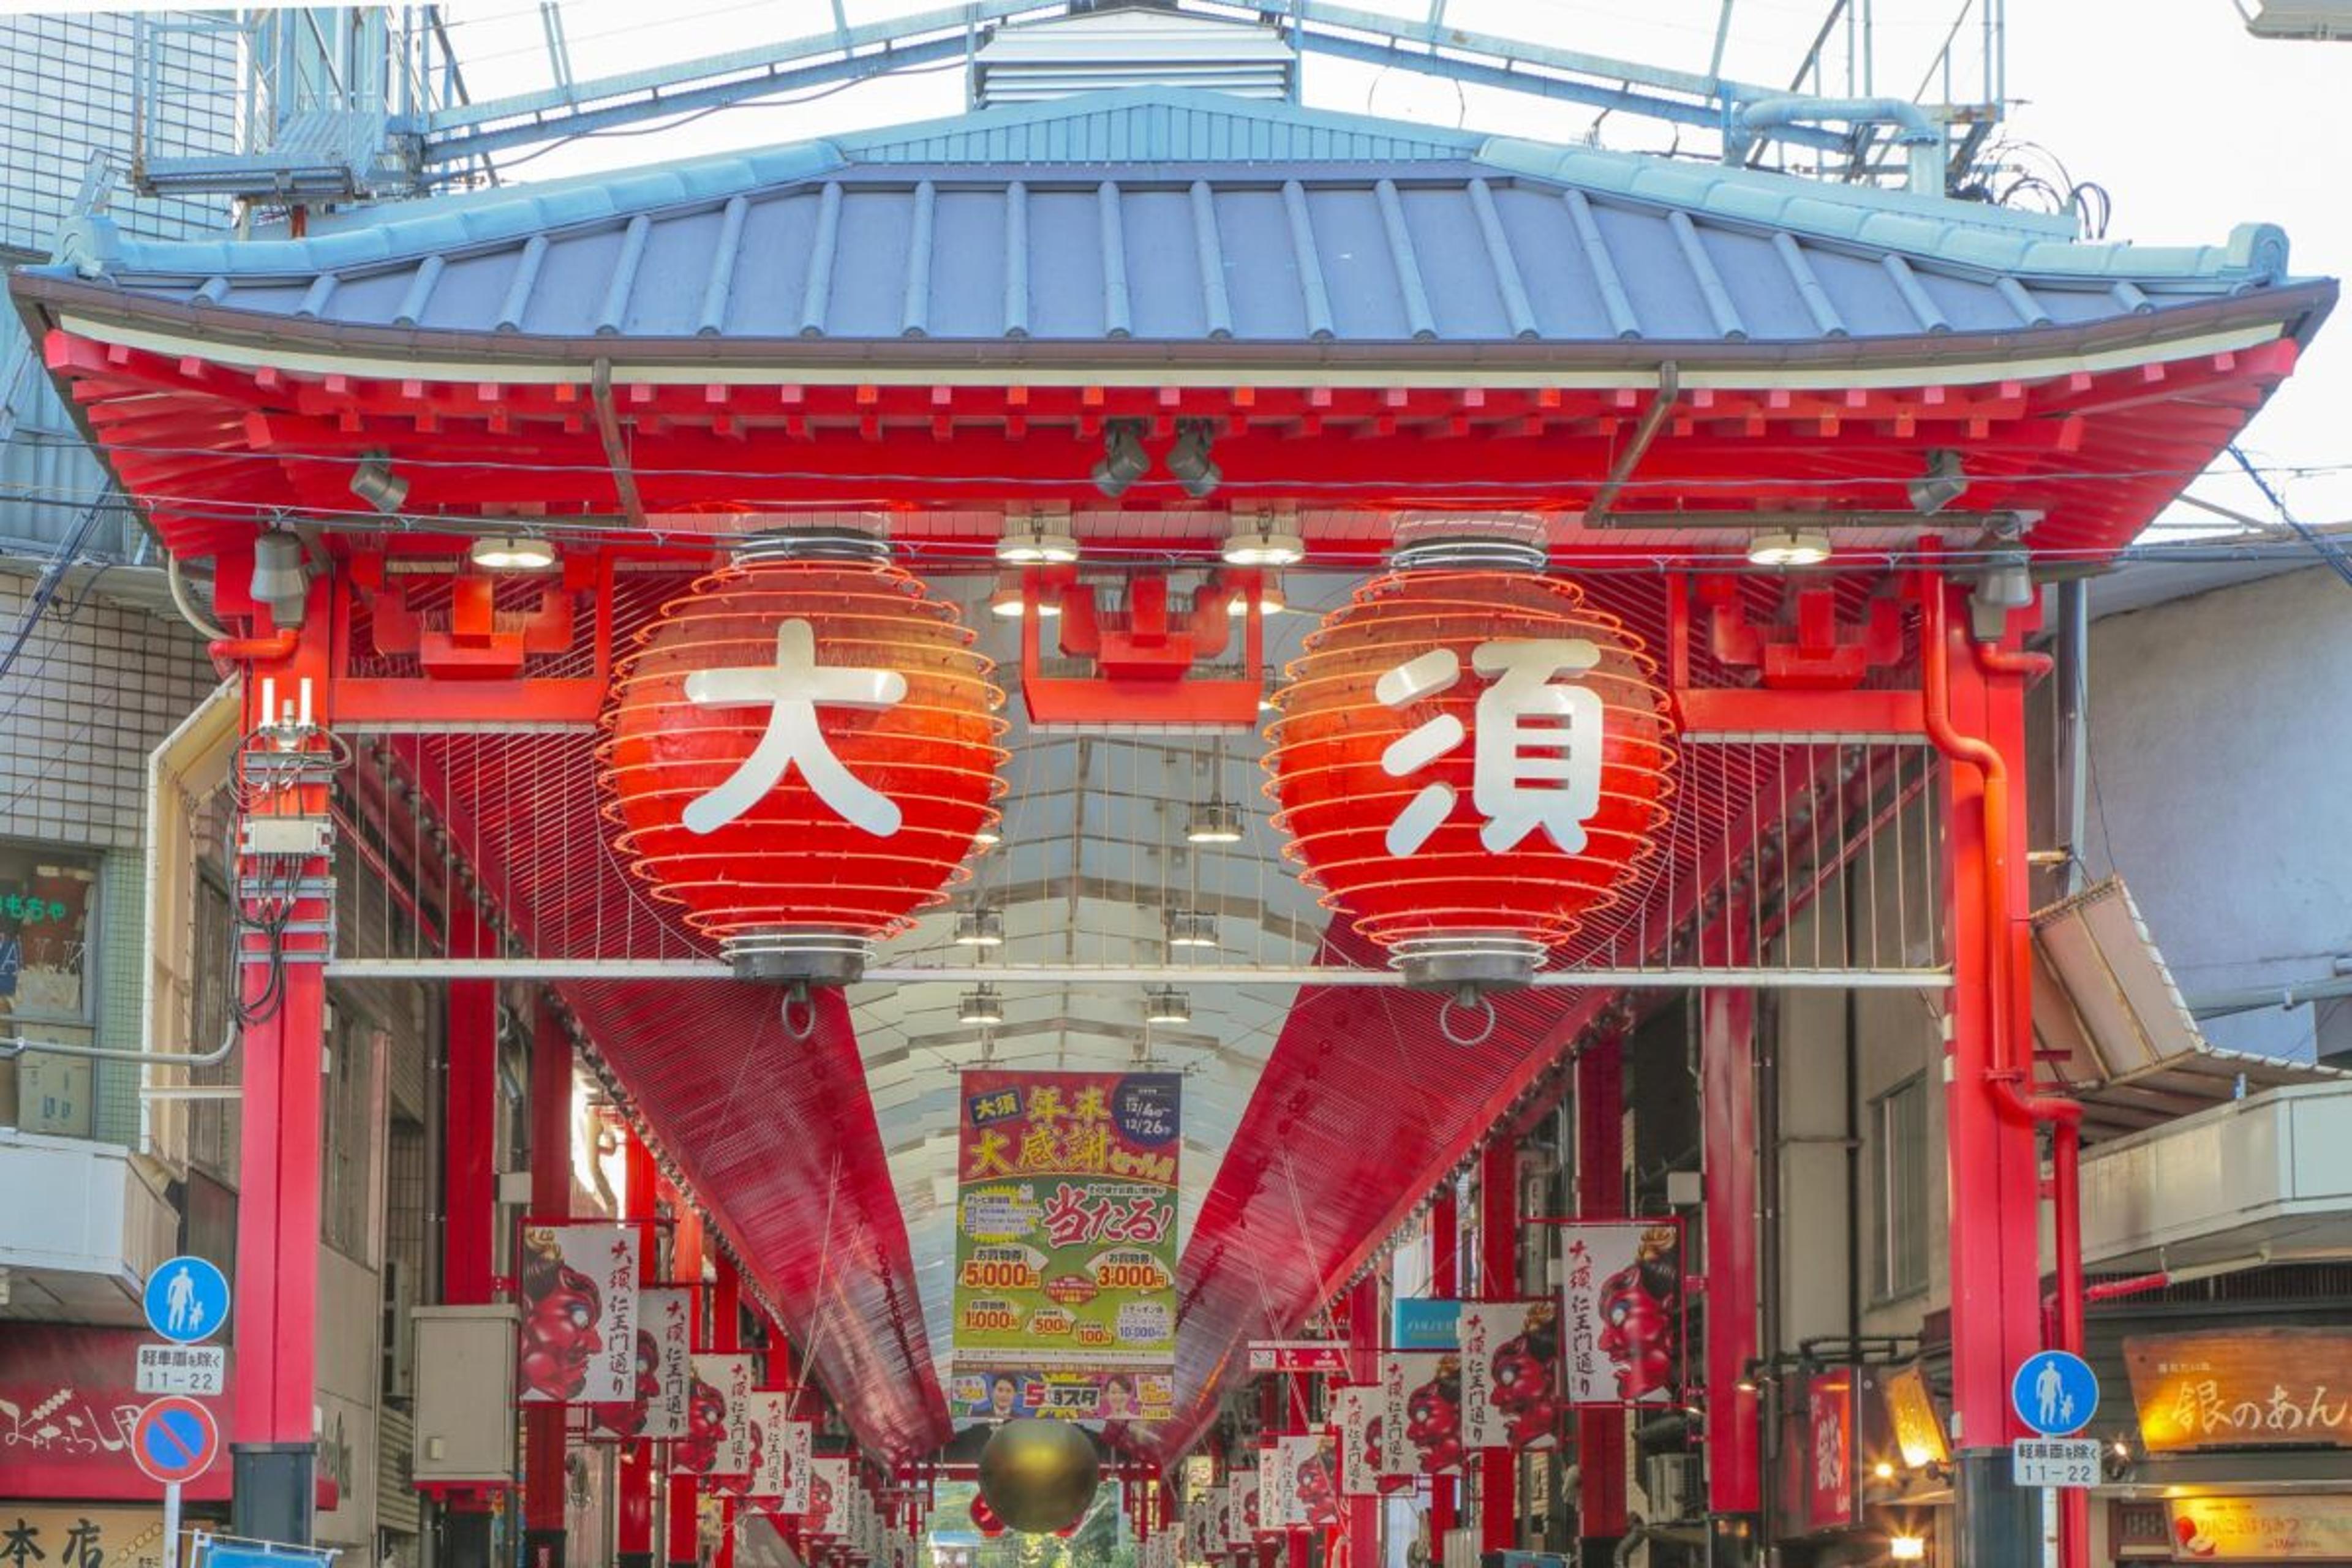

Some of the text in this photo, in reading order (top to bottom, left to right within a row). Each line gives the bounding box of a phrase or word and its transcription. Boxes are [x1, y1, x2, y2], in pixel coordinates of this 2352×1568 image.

[682, 619, 907, 837] 大
[1375, 638, 1604, 858] 須
[0, 894, 66, 922] もちゃ
[975, 1095, 1017, 1118] 大須
[141, 1351, 219, 1368] 軽車両を除く
[148, 1372, 212, 1389] 11-22
[2171, 1379, 2347, 1434] 銀のあん
[2018, 1444, 2097, 1460] 軽車両を除く
[2026, 1466, 2090, 1482] 11-22
